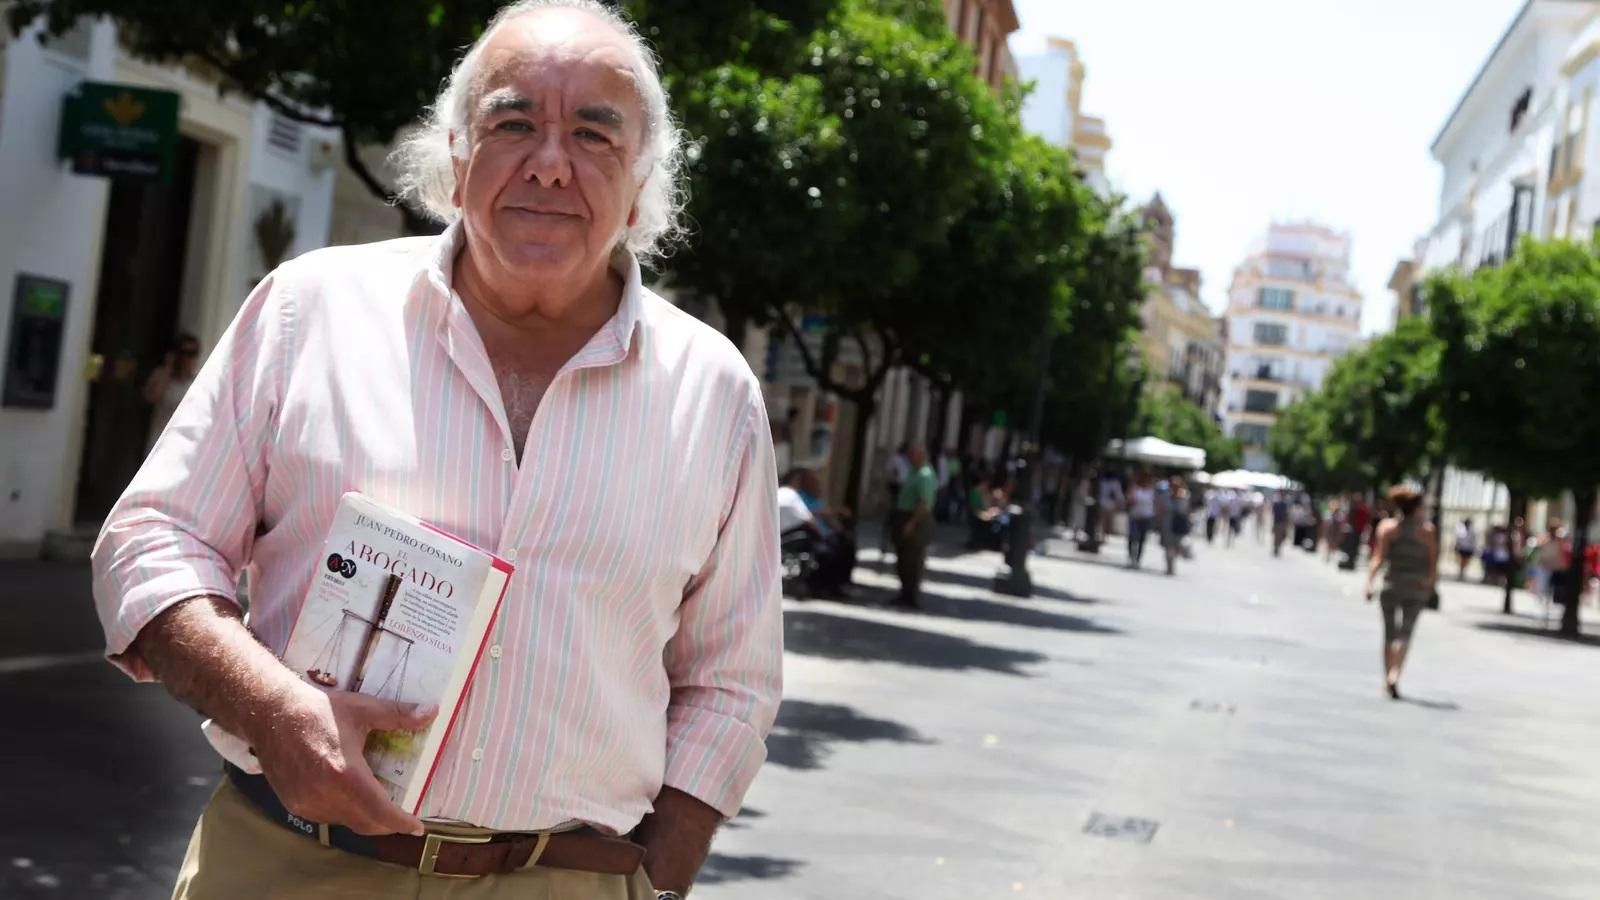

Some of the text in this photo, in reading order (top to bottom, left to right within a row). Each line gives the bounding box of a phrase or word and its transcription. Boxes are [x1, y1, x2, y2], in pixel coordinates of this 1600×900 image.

[353, 514, 463, 568] JUAN PEDRO COSANO
[344, 540, 453, 599] ABOGADO
[388, 619, 429, 643] LORENZO
[430, 639, 453, 655] SILVA
[288, 814, 313, 833] POLO
